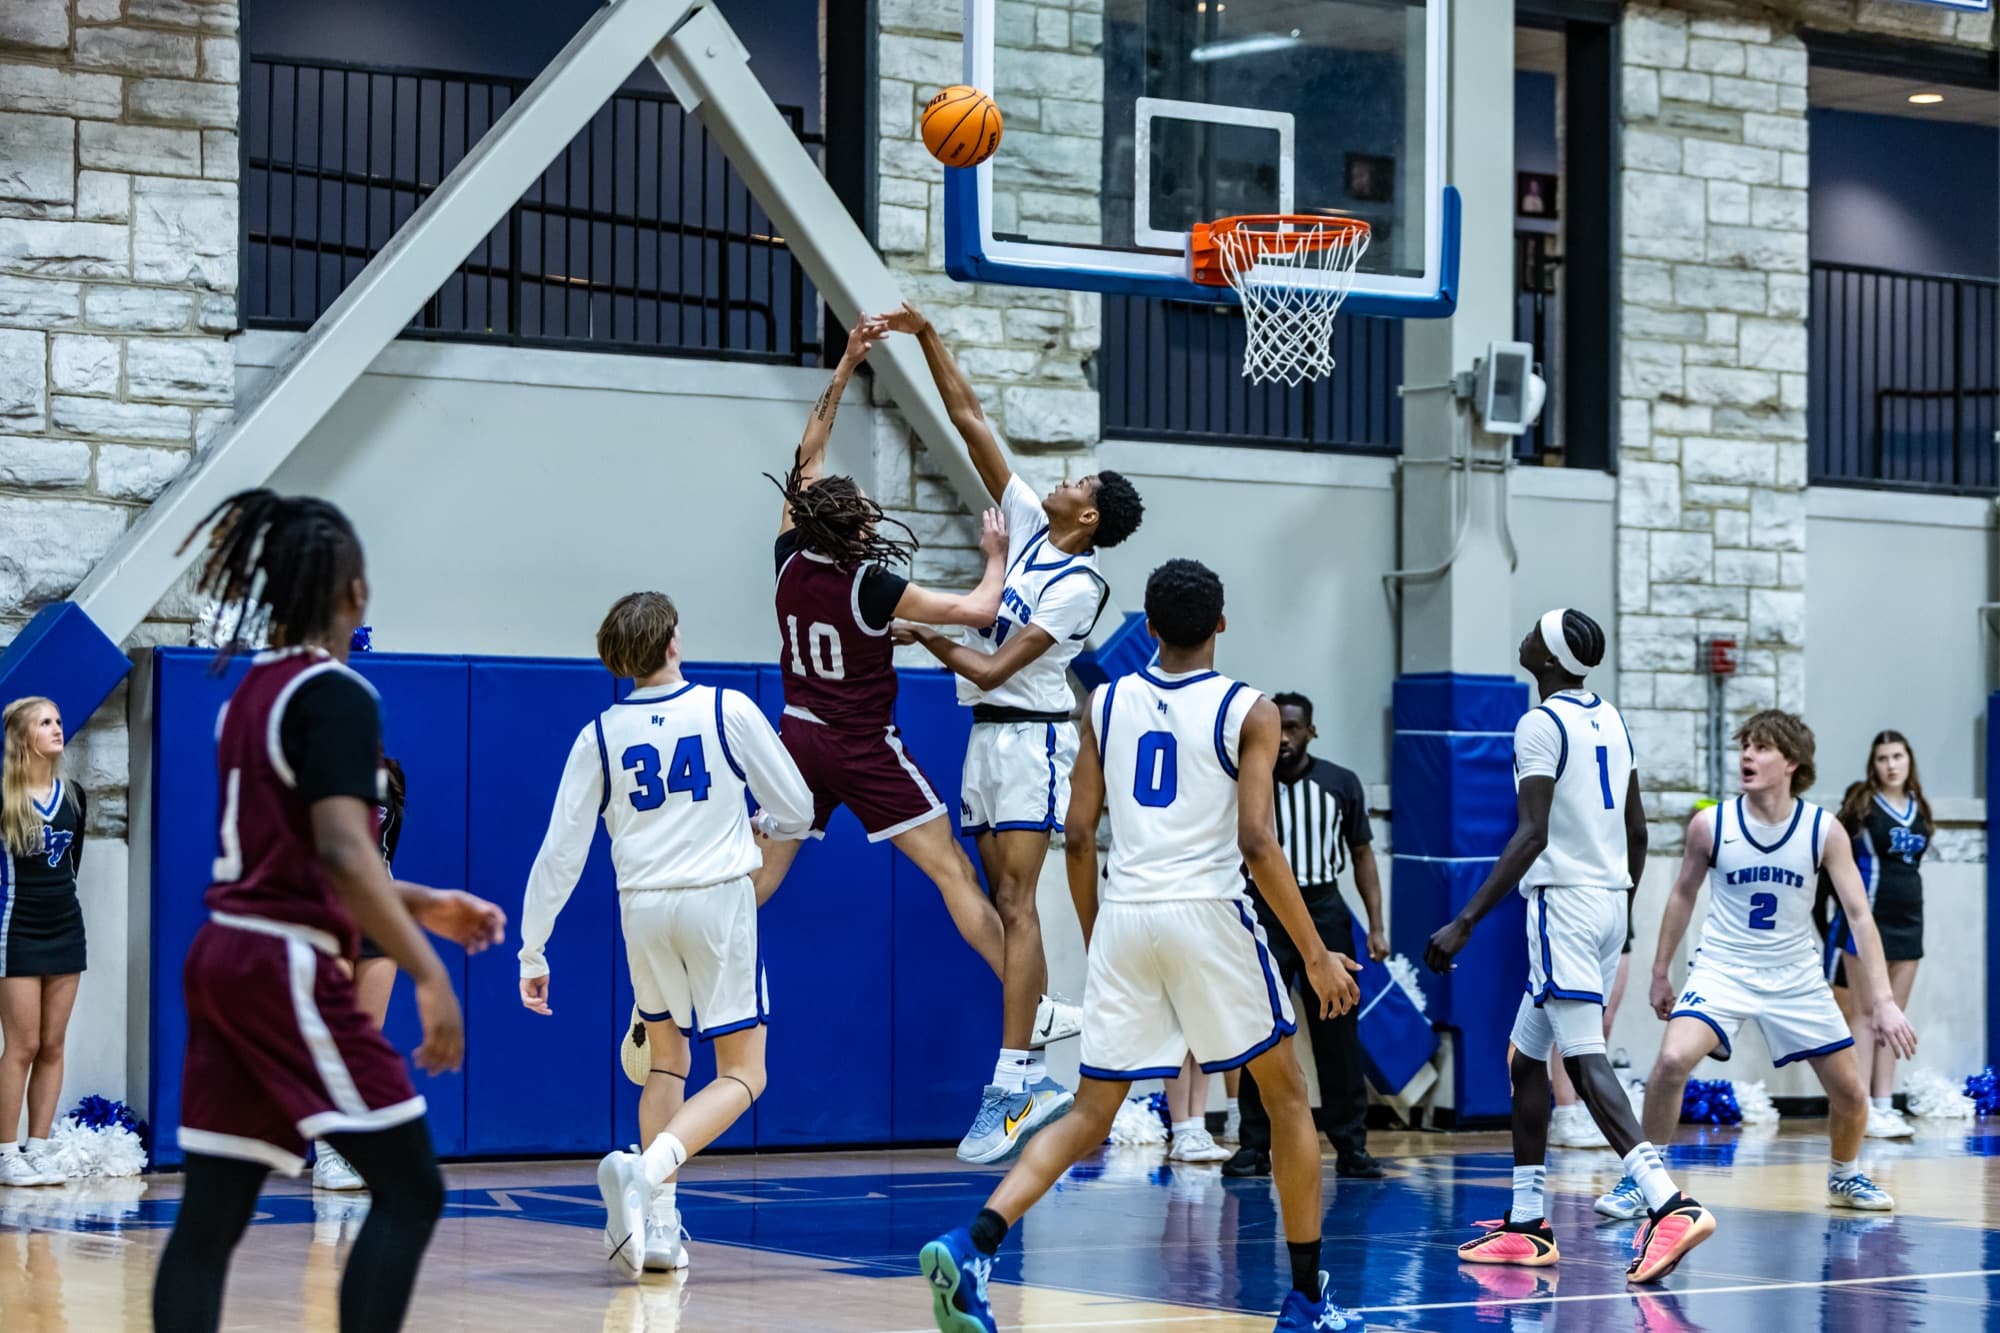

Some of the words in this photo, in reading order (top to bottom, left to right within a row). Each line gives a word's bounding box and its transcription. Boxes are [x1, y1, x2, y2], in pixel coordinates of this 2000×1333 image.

[786, 614, 846, 680] 10
[621, 734, 712, 813] 34
[1133, 730, 1178, 808] 0
[1596, 745, 1615, 810] 1
[1725, 865, 1805, 889] KNIGHTS
[1748, 891, 1778, 931] 2
[1679, 990, 1707, 1007] HF
